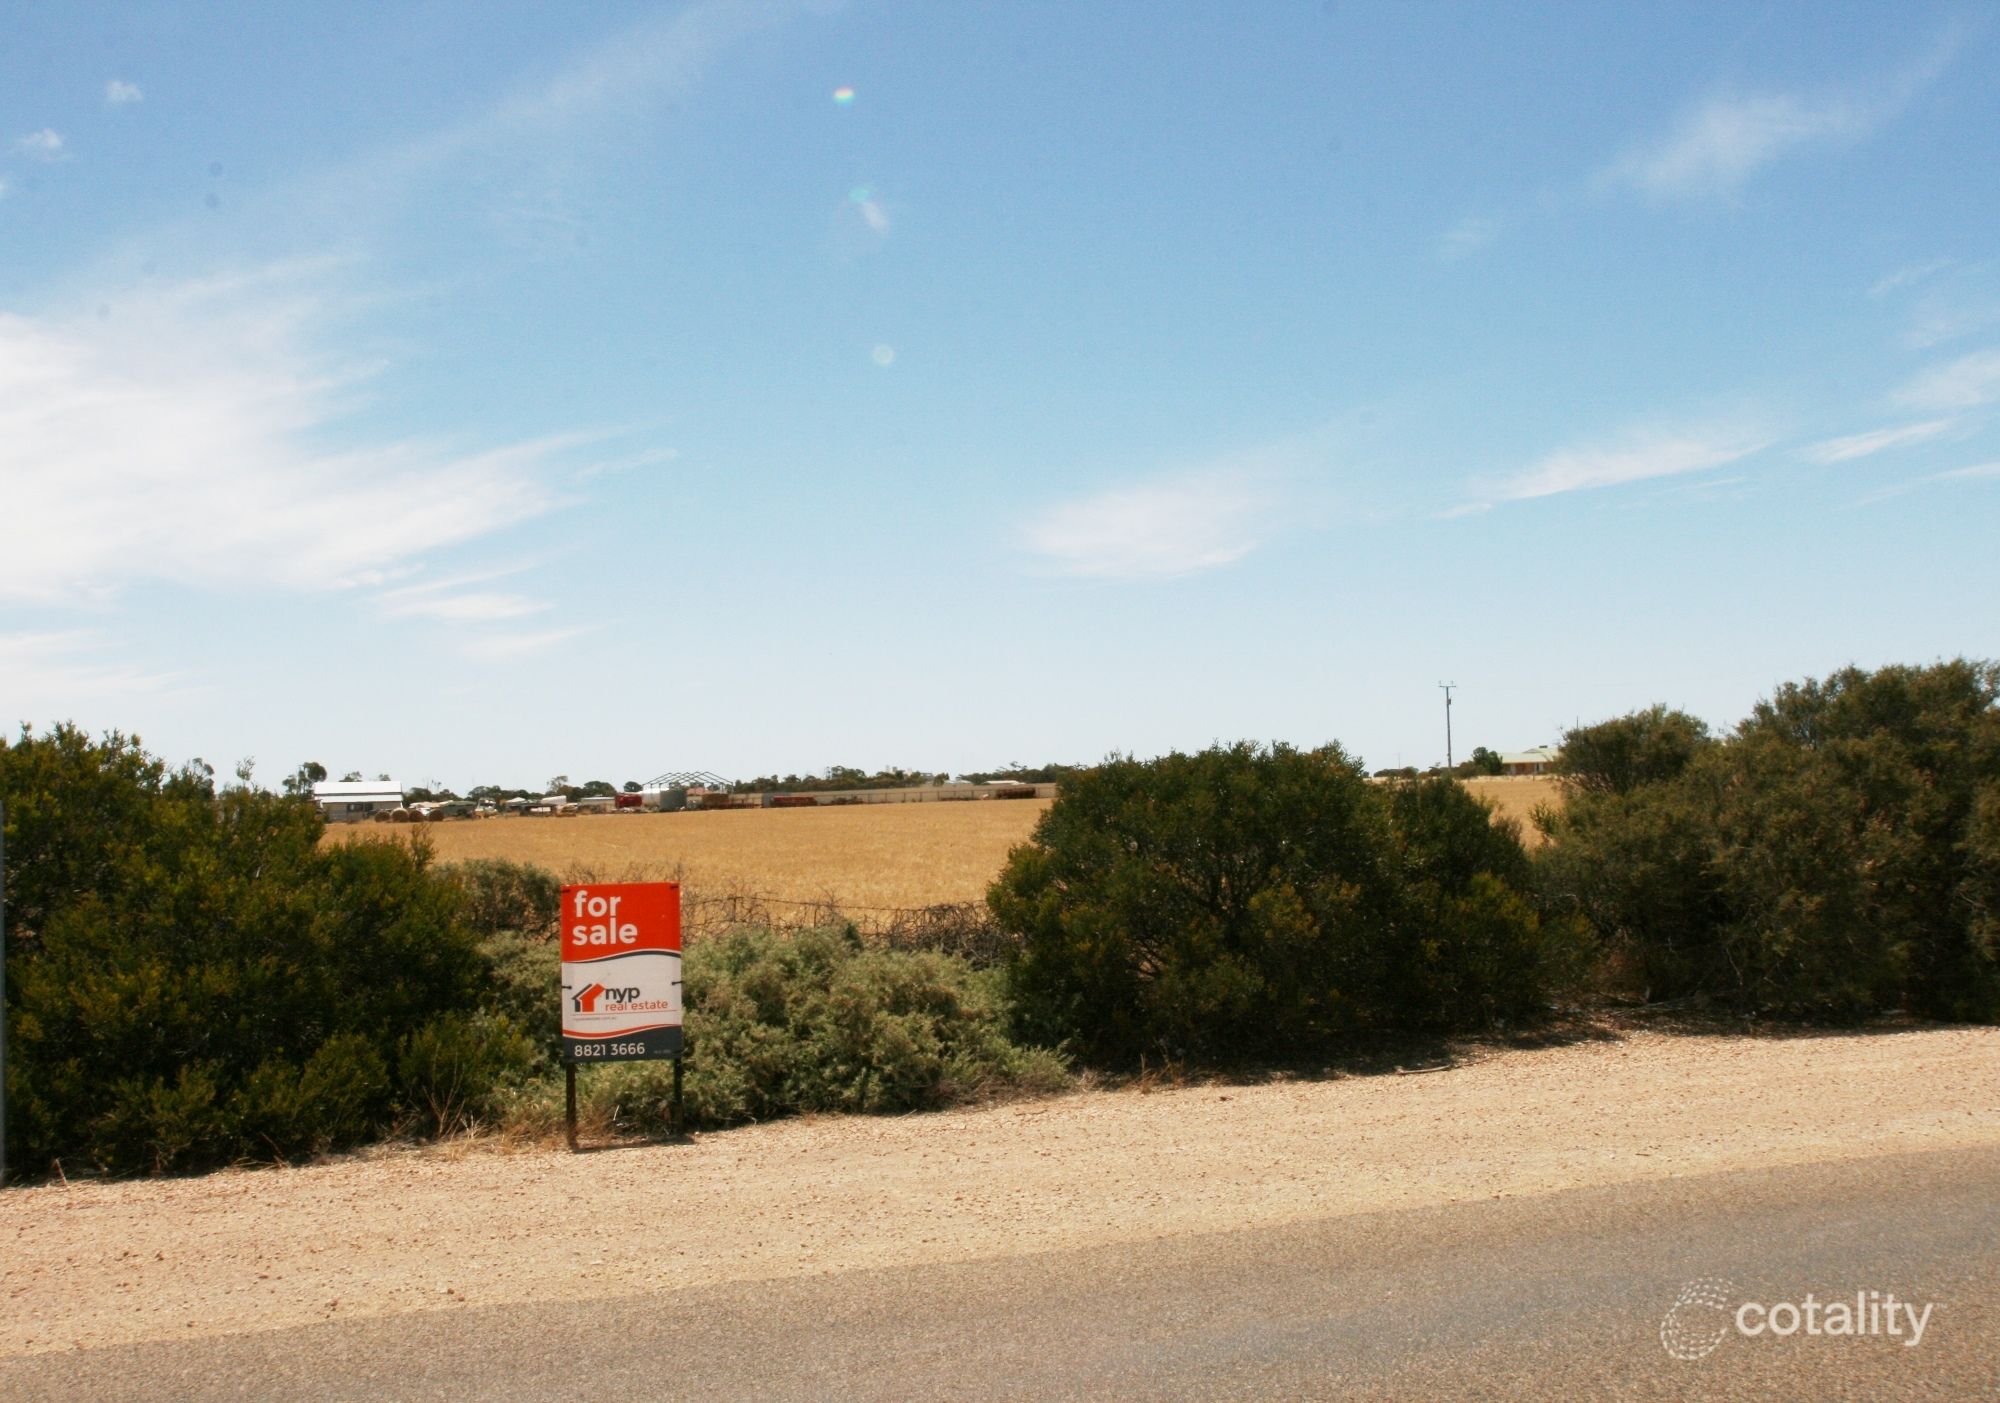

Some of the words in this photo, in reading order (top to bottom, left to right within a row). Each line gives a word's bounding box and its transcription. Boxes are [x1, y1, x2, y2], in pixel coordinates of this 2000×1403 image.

[574, 890, 621, 918] for
[572, 918, 638, 946] sale
[605, 986, 640, 1003] nyp
[605, 1001, 628, 1012] real
[631, 999, 668, 1010] estate
[574, 1044, 606, 1057] 8821
[611, 1042, 645, 1056] 3666
